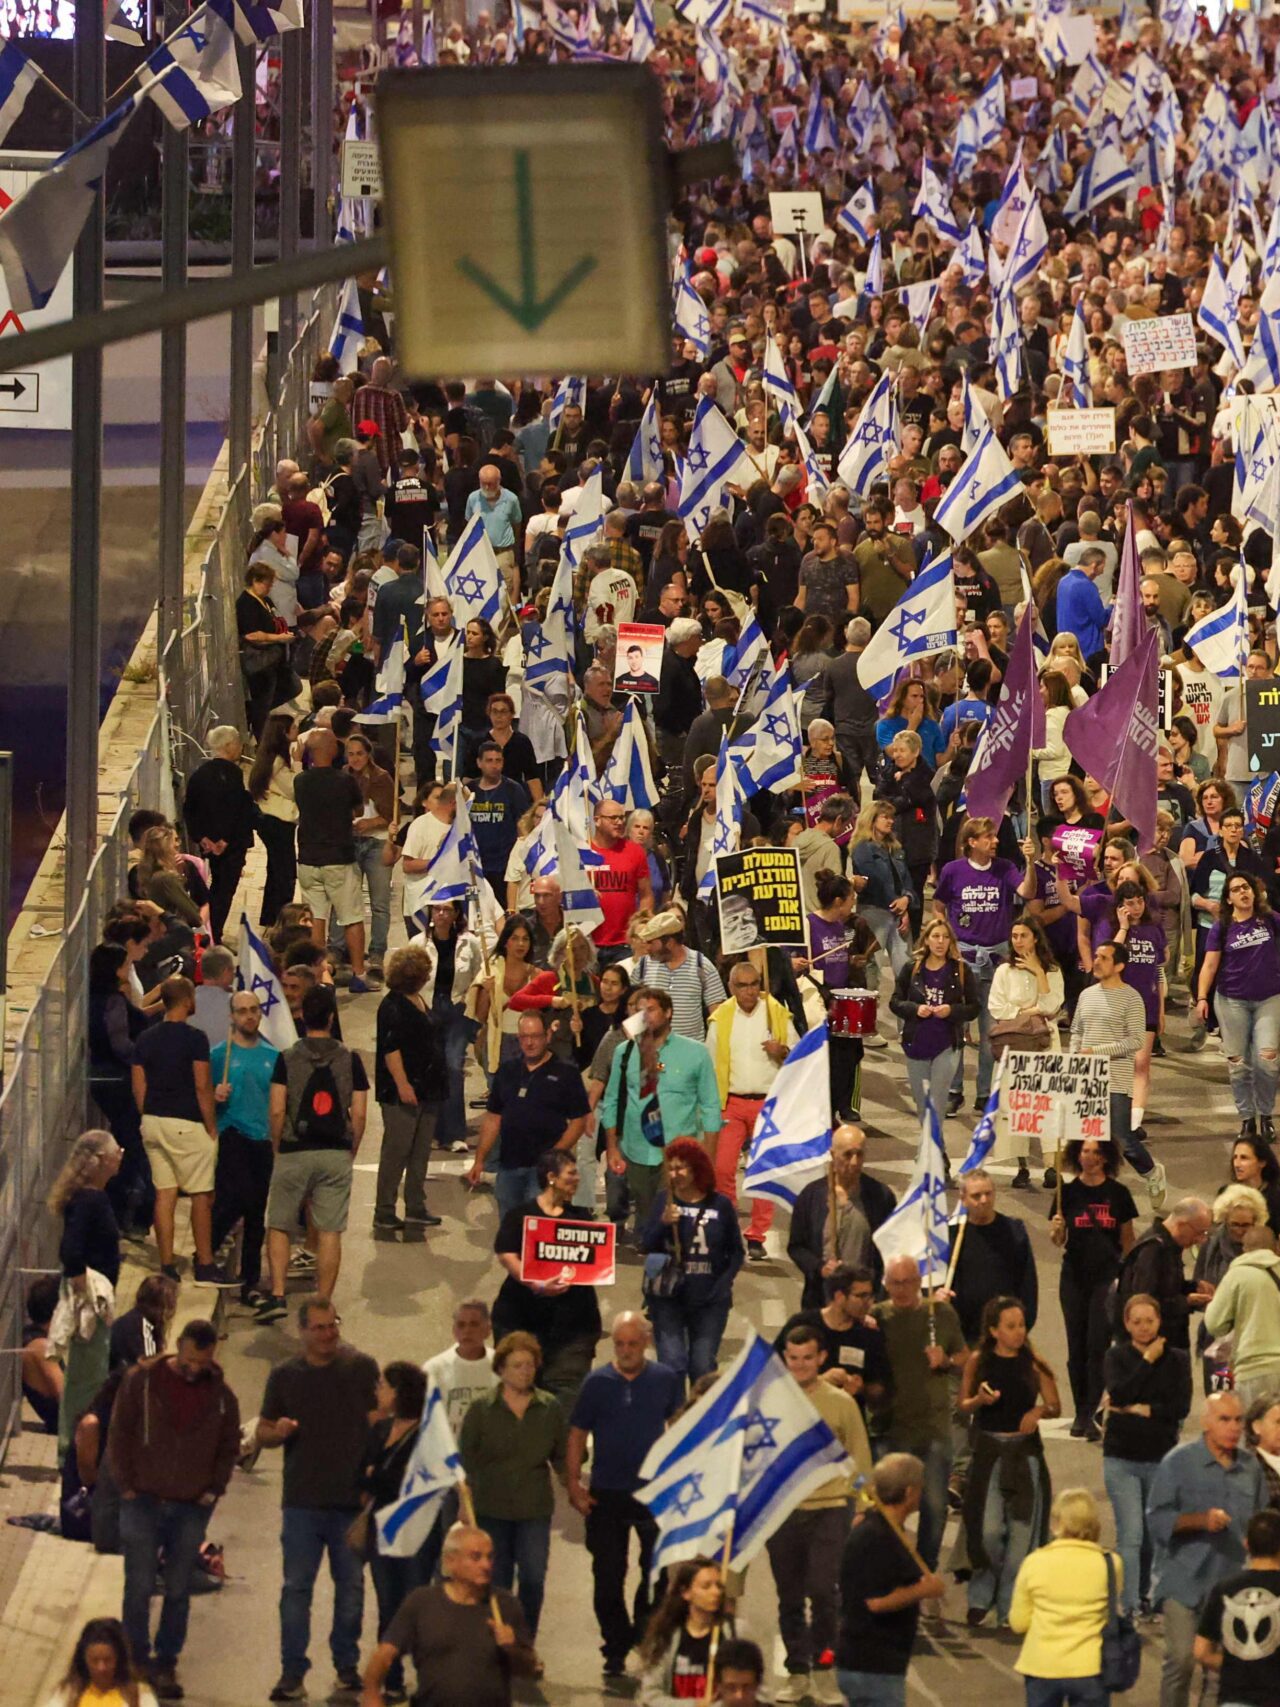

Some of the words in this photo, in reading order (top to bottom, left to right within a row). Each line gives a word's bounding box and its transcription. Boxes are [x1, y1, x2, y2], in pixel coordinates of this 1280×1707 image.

[1187, 682, 1208, 693] אתה
[1185, 692, 1212, 704] הראש
[743, 852, 794, 870] ממשלת
[722, 871, 755, 892] הבית
[757, 868, 796, 884] חורבן
[753, 884, 797, 900] קורעת
[962, 892, 985, 900] שלום
[778, 900, 799, 914] את
[764, 915, 801, 931] העם!
[1093, 1058, 1108, 1078] אין
[1081, 1078, 1109, 1099] עוצמה
[589, 1231, 606, 1244] אין
[538, 1241, 590, 1262] לאונס!
